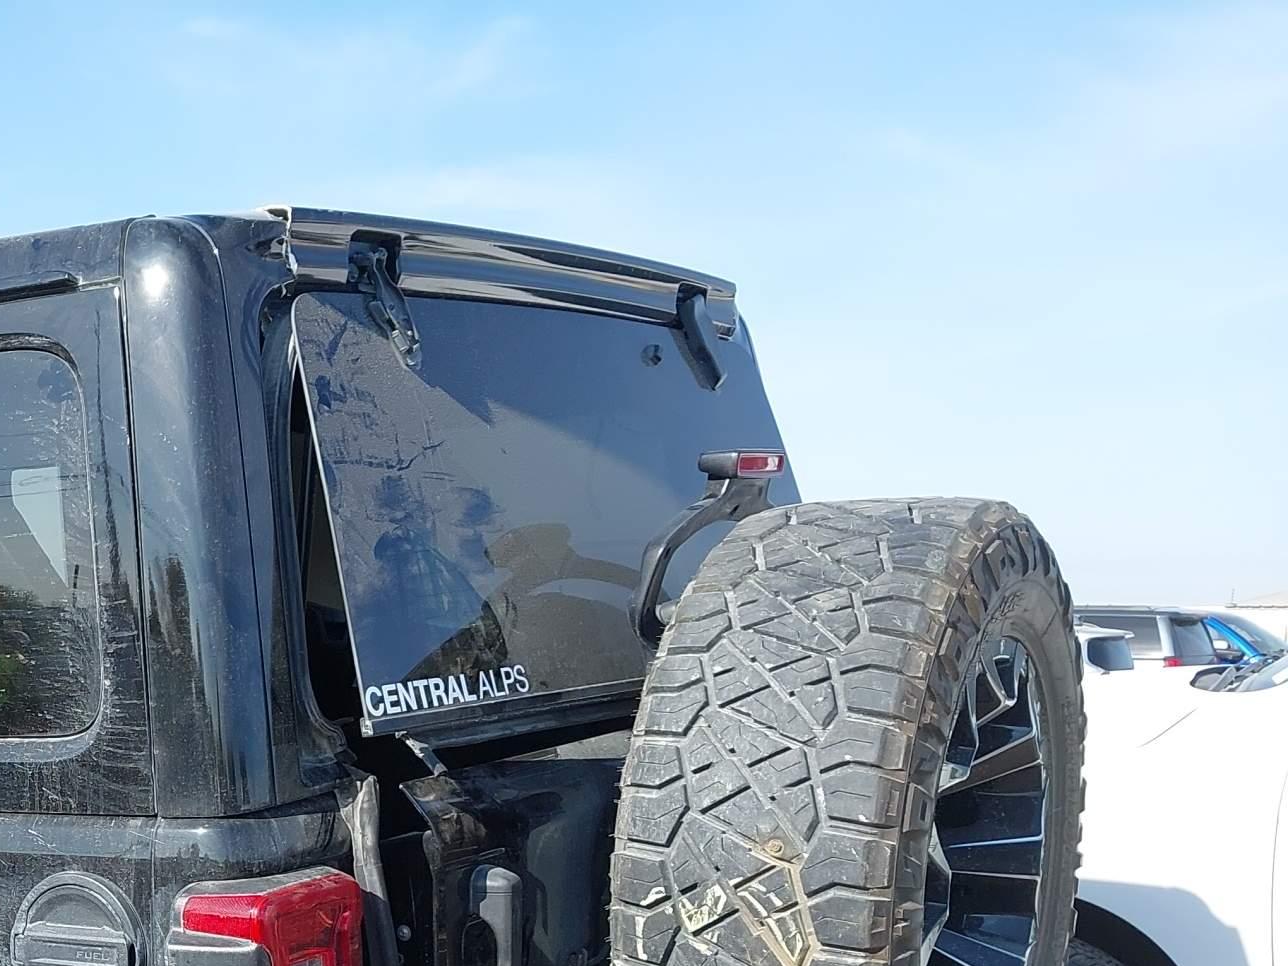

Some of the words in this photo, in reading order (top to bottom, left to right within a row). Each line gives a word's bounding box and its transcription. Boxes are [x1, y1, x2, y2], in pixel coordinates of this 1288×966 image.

[365, 674, 478, 717] CENTRAL
[478, 664, 530, 700] ALPS
[76, 950, 109, 961] FUEL
